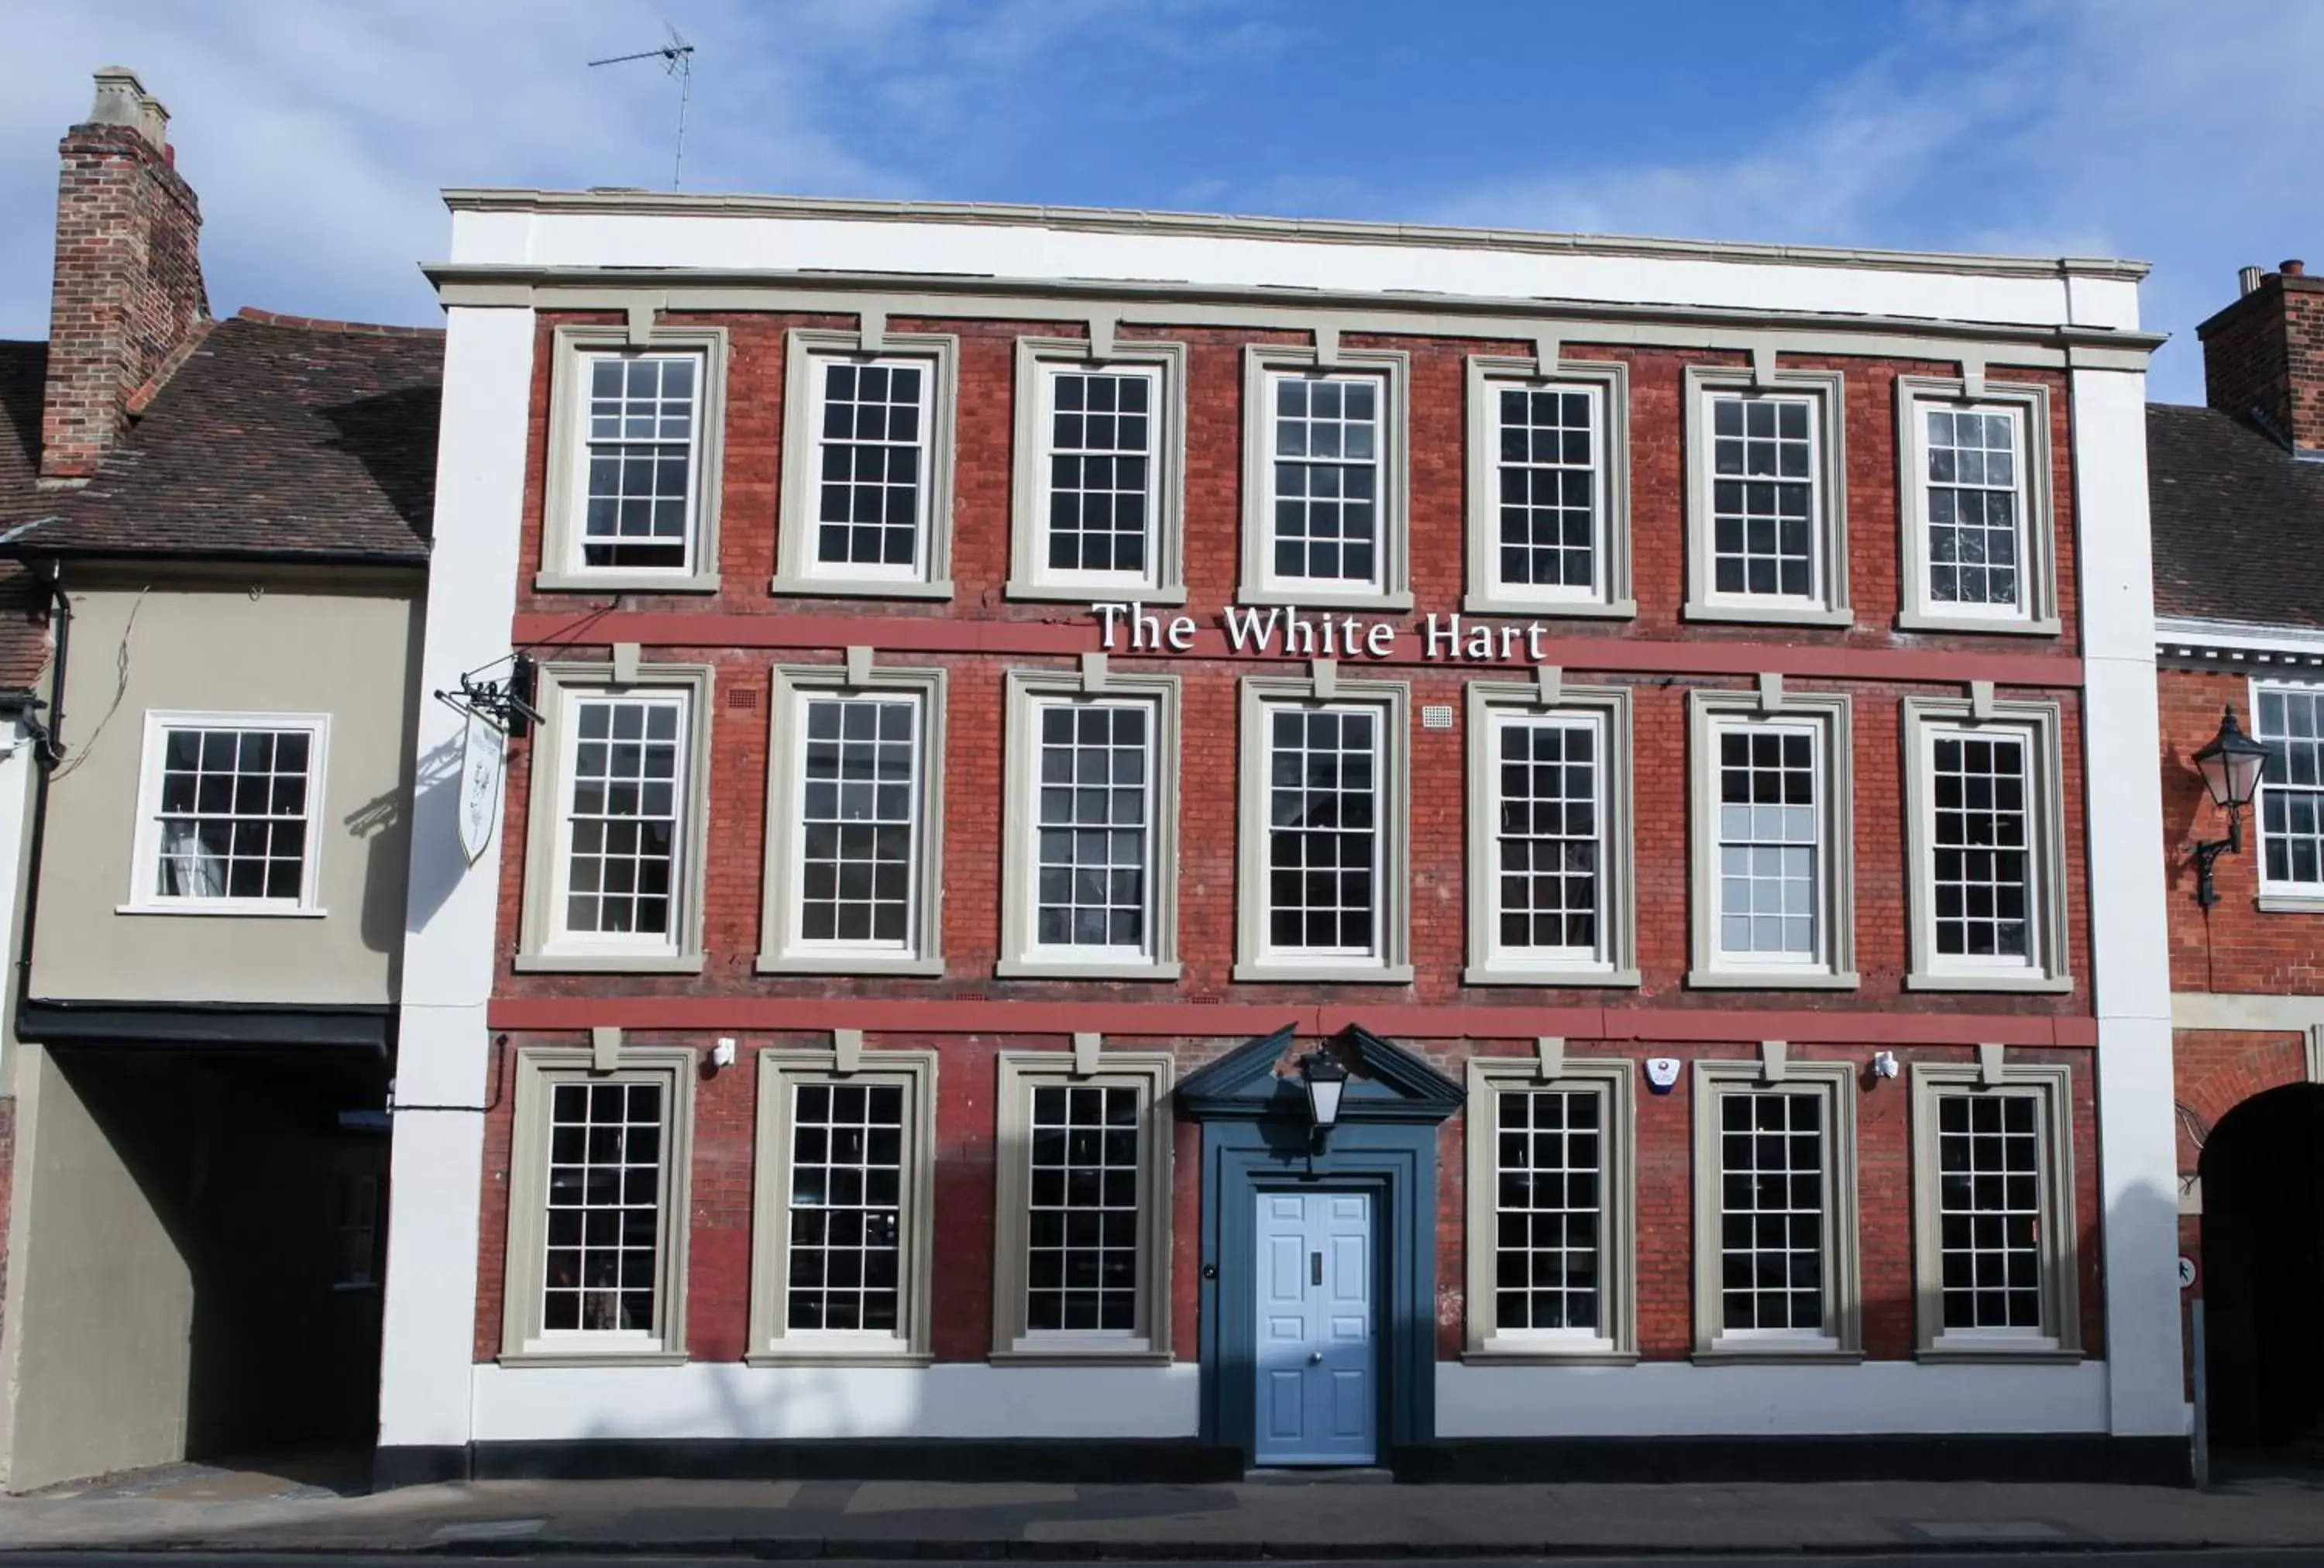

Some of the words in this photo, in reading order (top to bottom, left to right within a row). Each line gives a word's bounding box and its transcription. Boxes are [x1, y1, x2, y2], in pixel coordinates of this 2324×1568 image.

[1092, 601, 1195, 648] The
[1223, 605, 1394, 655] White
[1426, 613, 1548, 658] Hart
